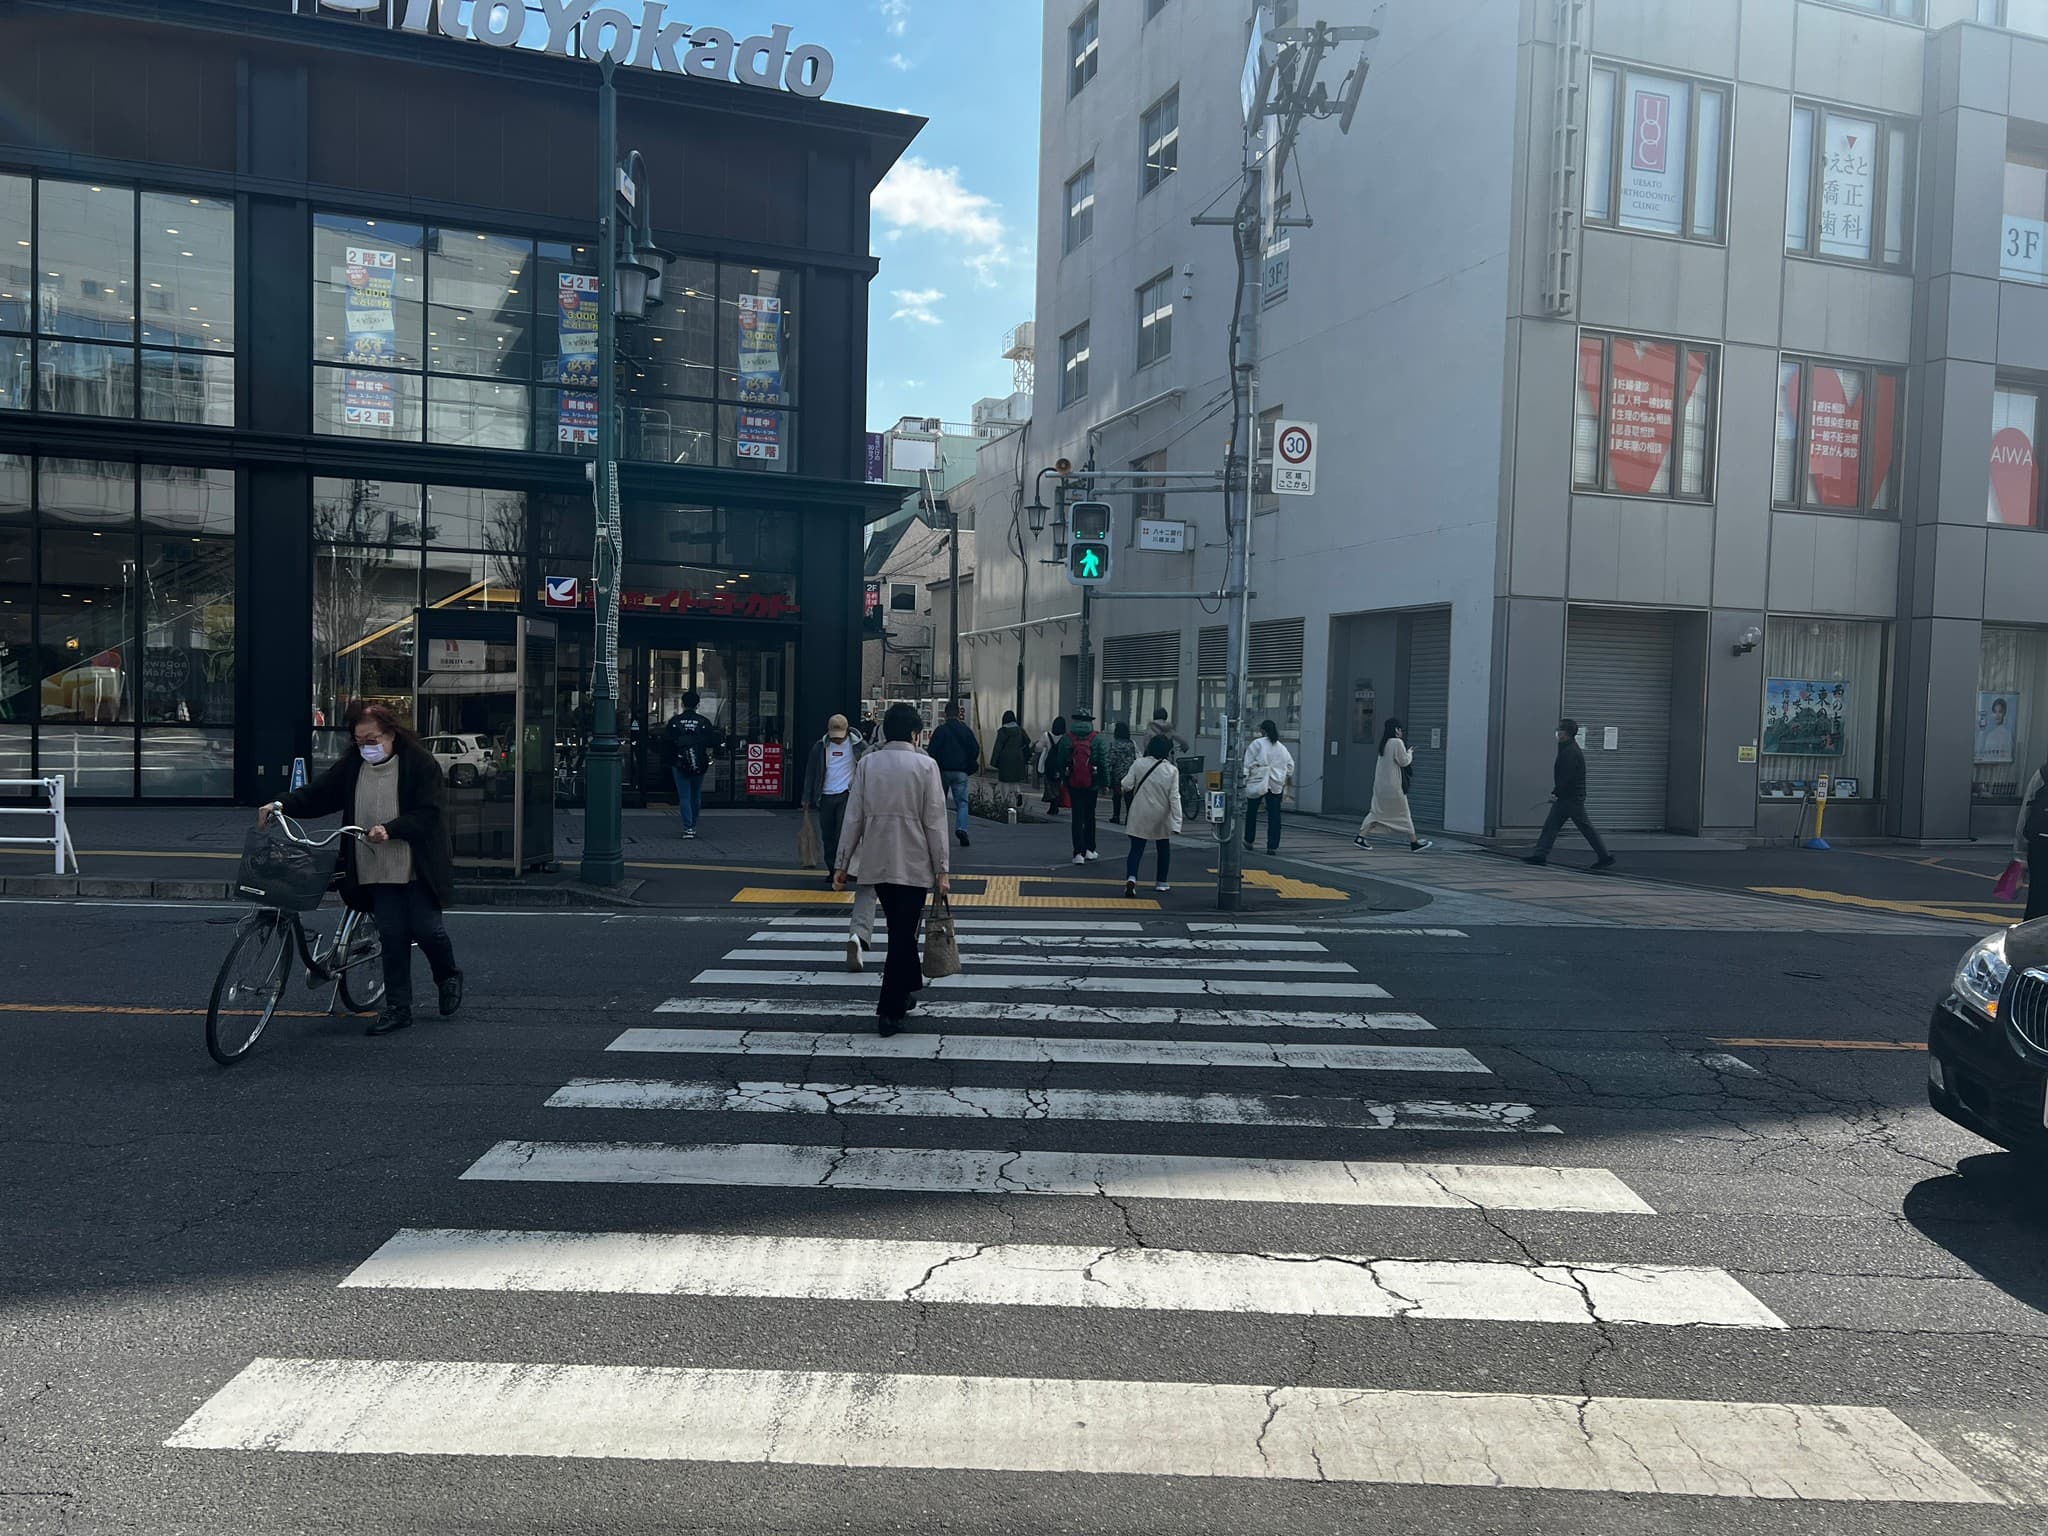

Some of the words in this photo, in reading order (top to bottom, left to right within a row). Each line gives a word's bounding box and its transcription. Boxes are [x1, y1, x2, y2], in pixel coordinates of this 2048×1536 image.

[1824, 151, 1868, 176] えさと
[1633, 177, 1662, 188] UESATO
[1624, 188, 1677, 202] RTHODONTIC
[1633, 201, 1661, 211] CLINIC
[1822, 210, 1863, 240] 歯科
[2006, 228, 2039, 259] 3F
[349, 250, 377, 265] 2階
[365, 410, 391, 425] 2階
[560, 429, 585, 441] 2階
[753, 445, 777, 458] 2階
[1286, 437, 1305, 454] 30
[1990, 445, 2033, 467] AIWA
[1285, 471, 1302, 480] 区域
[1278, 480, 1308, 489] ここから
[1153, 528, 1182, 537] 八十二銀行
[866, 583, 878, 592] 2F
[657, 589, 800, 619] イトーヨーカドー
[1818, 780, 1826, 798] 出口
